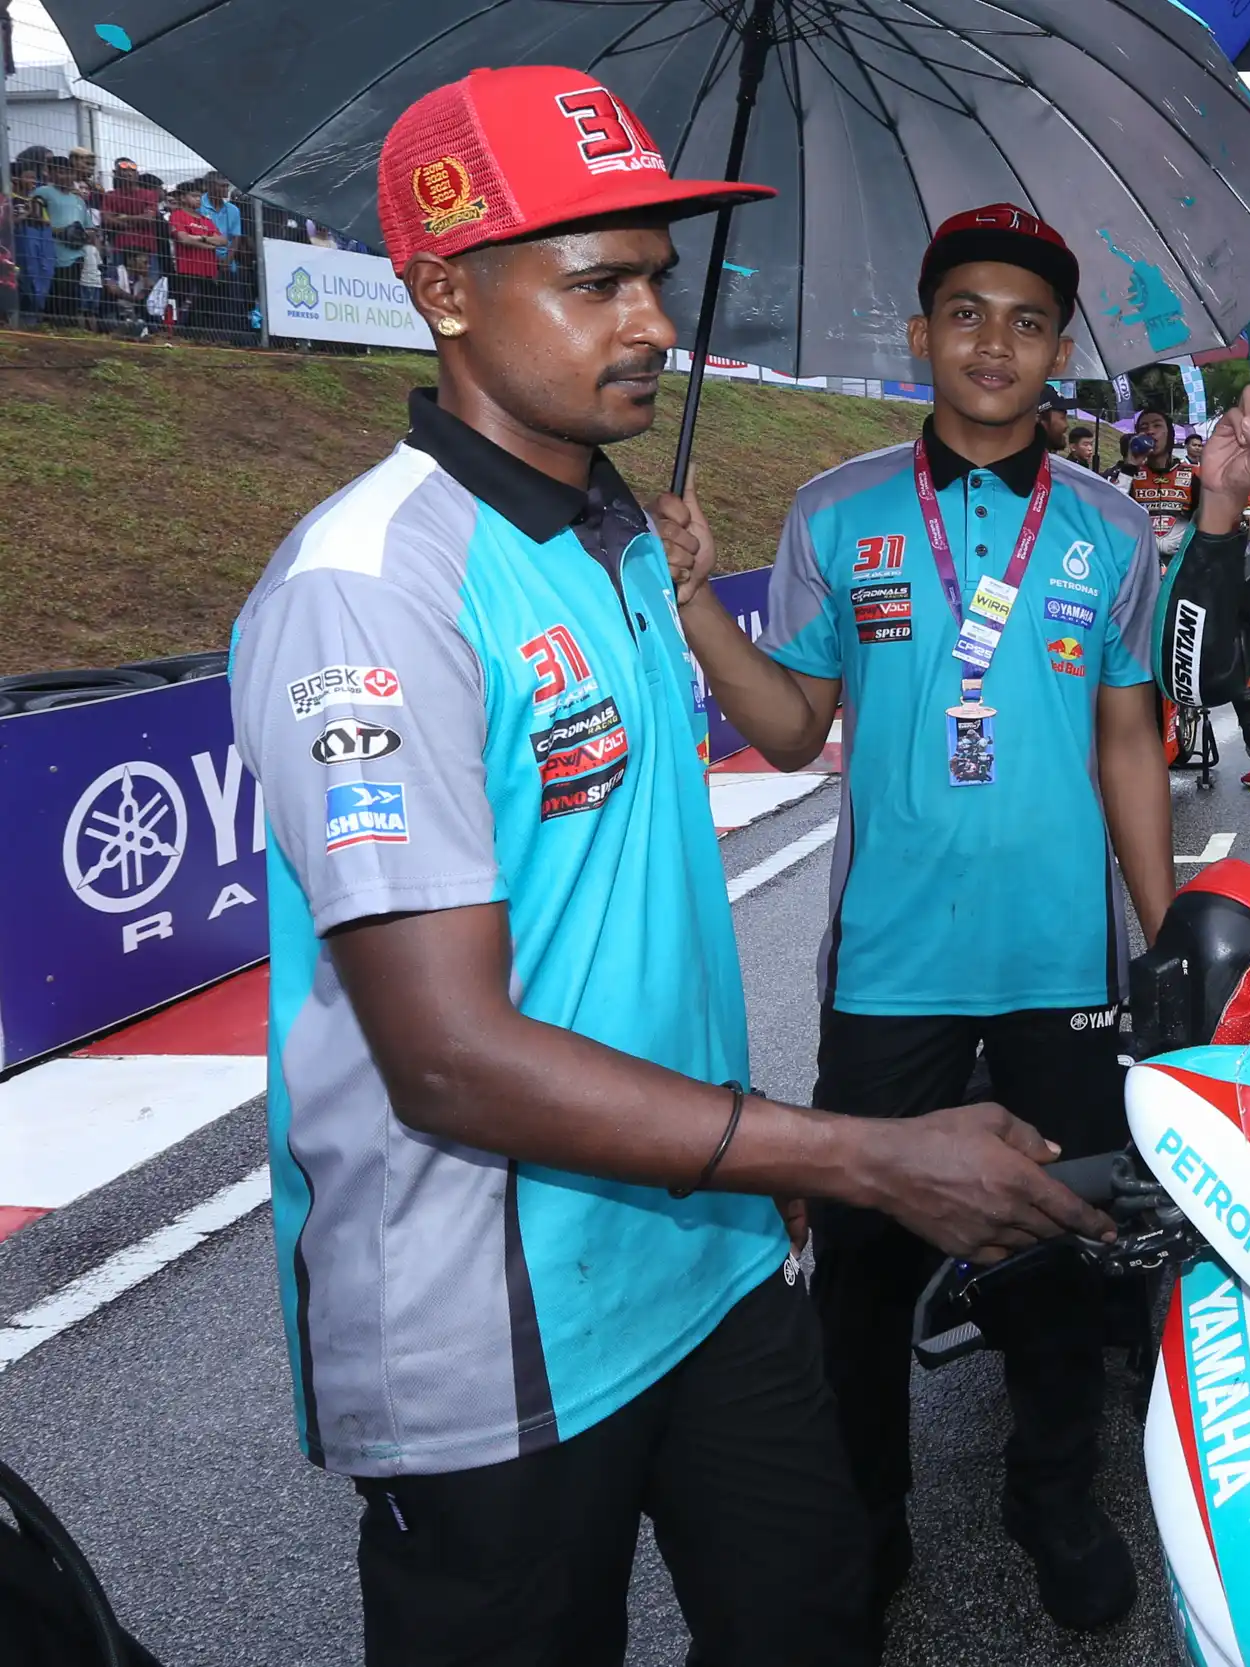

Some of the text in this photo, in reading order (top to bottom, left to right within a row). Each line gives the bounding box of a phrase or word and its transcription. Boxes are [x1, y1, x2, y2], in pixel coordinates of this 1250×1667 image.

[425, 170, 449, 186] 2020
[429, 181, 452, 195] 2021
[432, 189, 456, 205] 2022
[433, 208, 480, 235] CHAMPION
[325, 302, 415, 331] DIRI ANDA
[1135, 488, 1188, 499] HONDA
[852, 534, 906, 573] 31
[1049, 578, 1099, 597] PETRONAS
[976, 594, 1010, 616] WIRA
[1060, 602, 1094, 624] YAMAHA
[957, 639, 994, 659] CP125
[517, 624, 593, 705] 31
[1066, 663, 1086, 677] Bull
